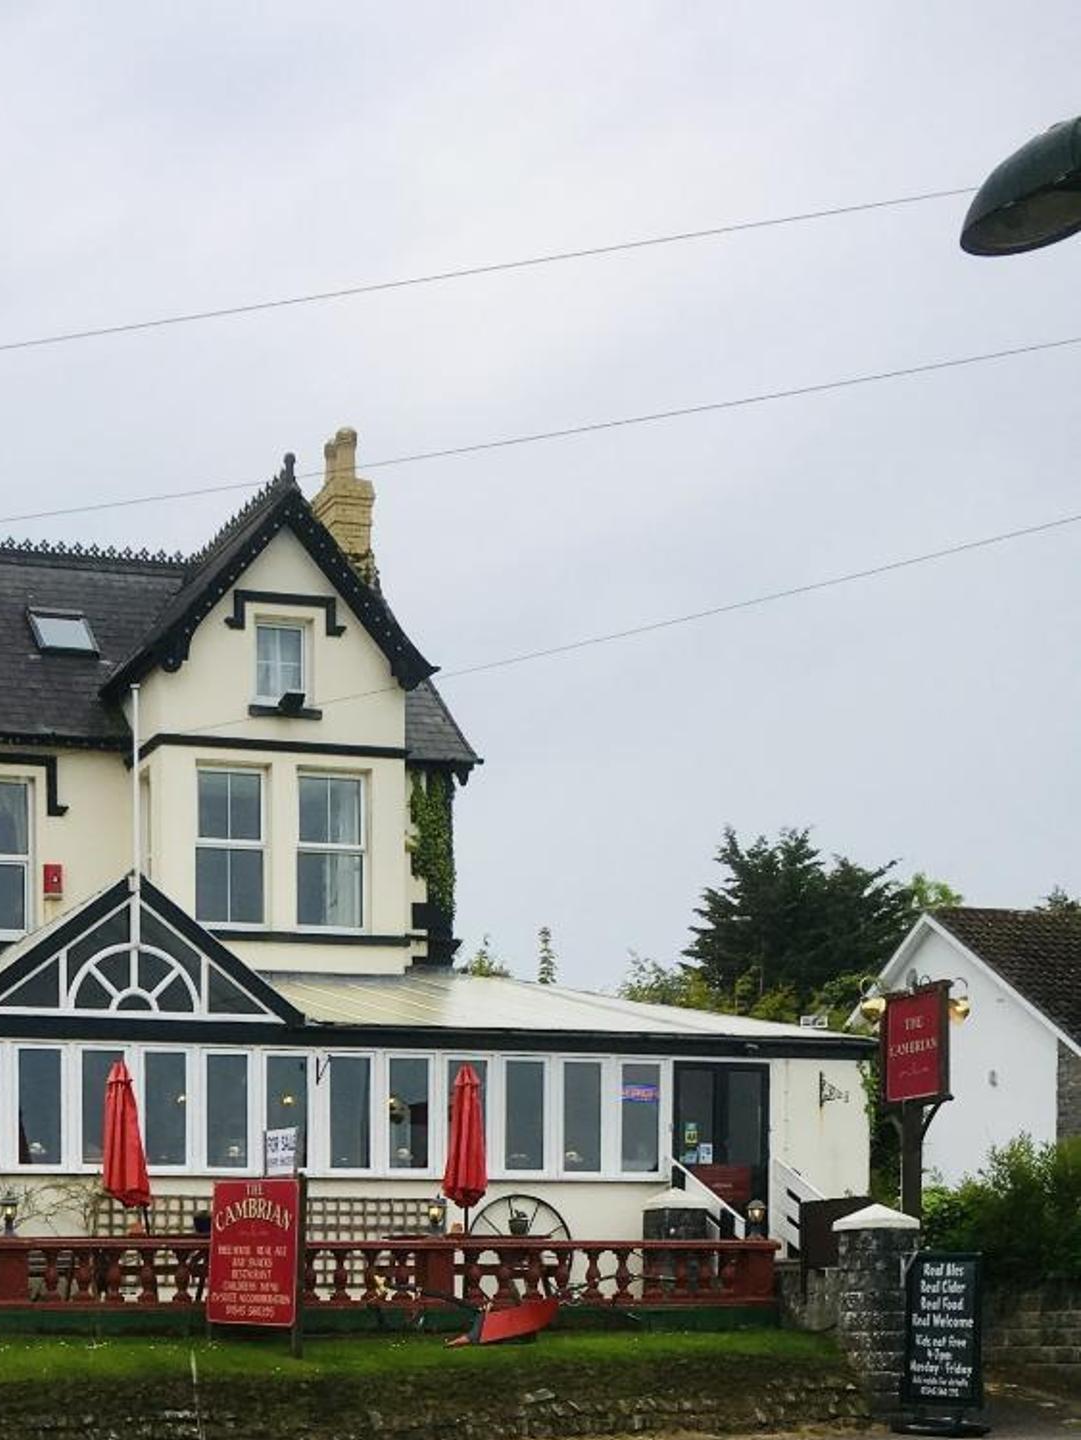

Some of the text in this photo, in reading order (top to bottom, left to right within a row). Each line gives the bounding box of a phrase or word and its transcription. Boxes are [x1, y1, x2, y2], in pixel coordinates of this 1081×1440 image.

[904, 1016, 924, 1030] THE
[889, 1037, 937, 1060] CAMBRIAN
[246, 1183, 264, 1195] THE
[215, 1197, 292, 1231] CAMBRIAN
[923, 1262, 944, 1276] Real
[920, 1279, 966, 1293] Real Cider
[920, 1295, 964, 1310] Real Food
[911, 1312, 975, 1328] Real Welcome
